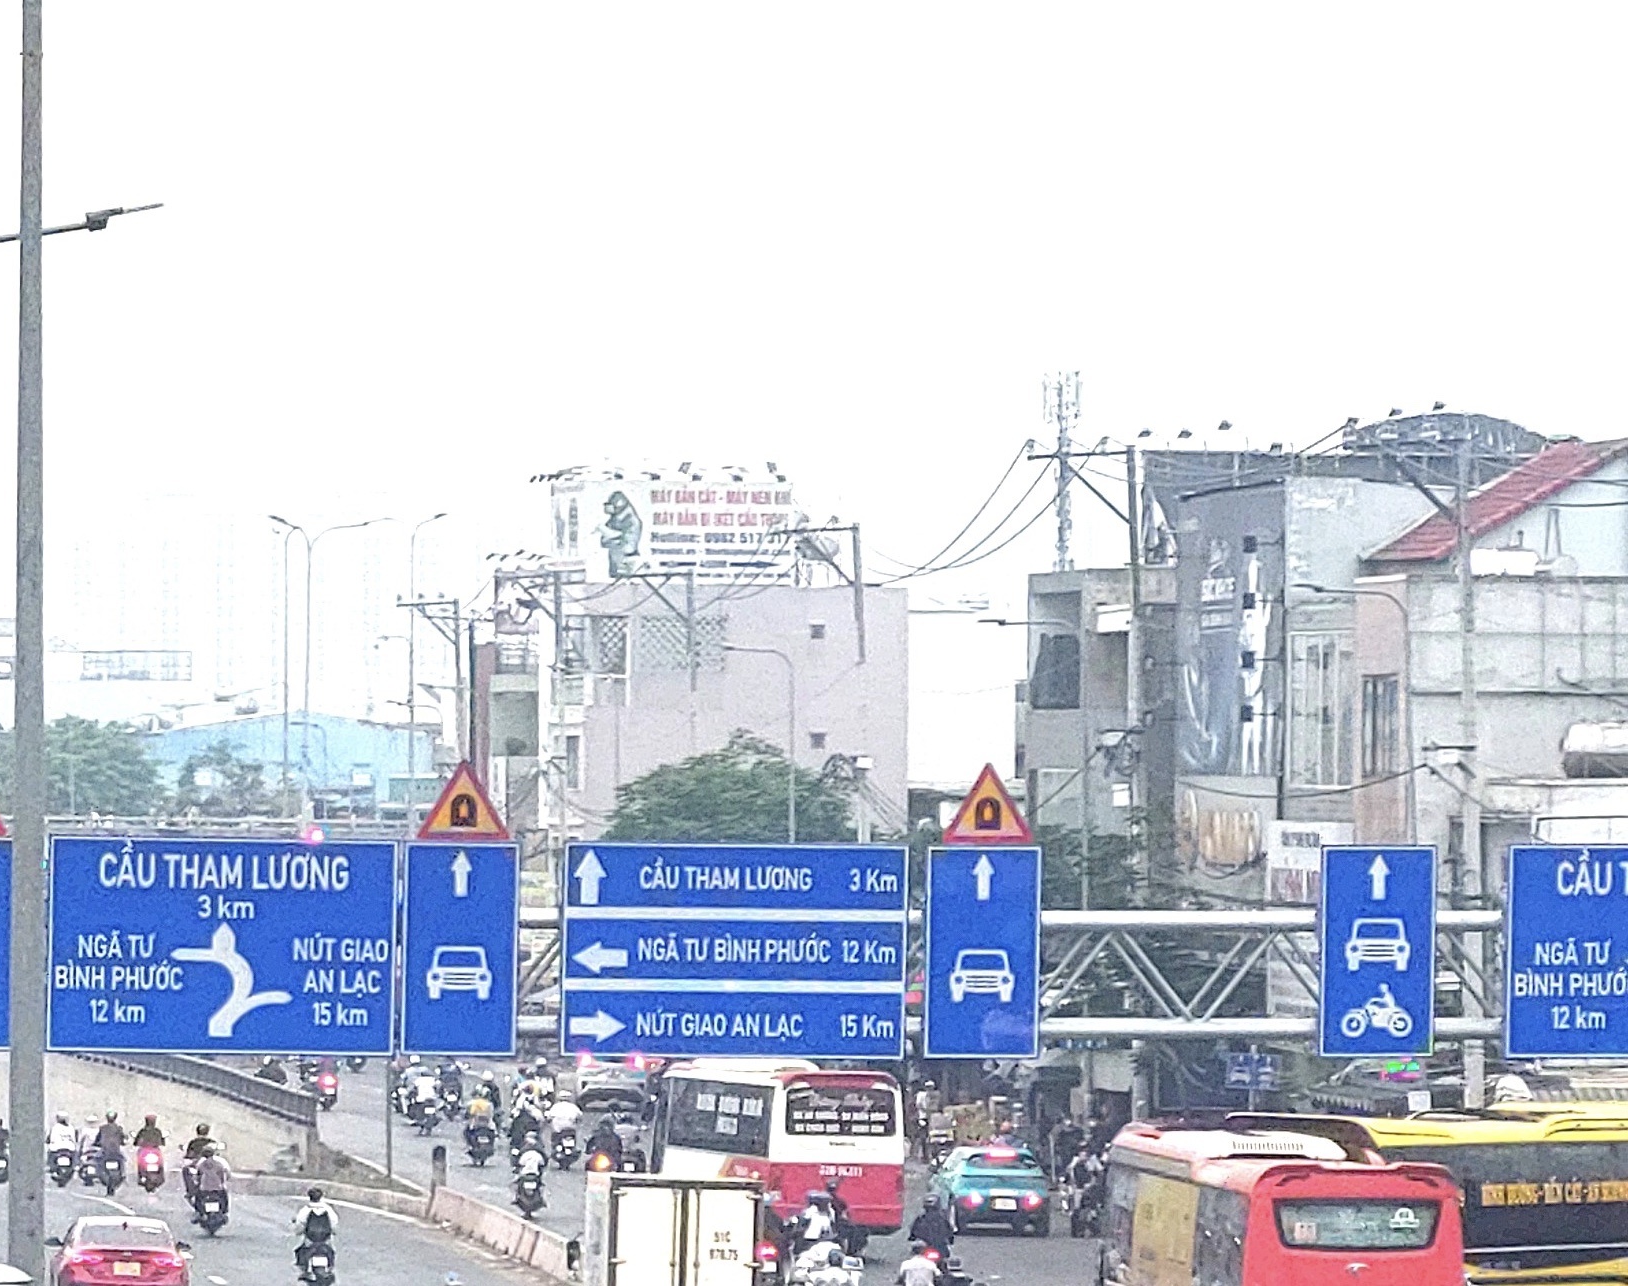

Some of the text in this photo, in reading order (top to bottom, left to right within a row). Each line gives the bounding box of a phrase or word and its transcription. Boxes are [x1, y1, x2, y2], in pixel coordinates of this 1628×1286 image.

[99, 843, 348, 890] CẦU THAM LƯƠNG
[640, 857, 811, 890] CẦU THAM LƯƠNG
[1557, 850, 1612, 895] CẦU
[850, 869, 897, 892] 3 Km
[198, 896, 254, 918] 3 km
[79, 930, 154, 957] NGÃ TƯ
[294, 933, 388, 962] NÚT GIAO
[639, 933, 830, 962] NGÃ TƯ BÌNH PHƯỚC
[843, 941, 895, 963] 12 Km
[1536, 938, 1612, 965] NGÃ TƯ
[55, 960, 183, 990] BÌNH PHƯỚC
[304, 970, 380, 997] AN LẠC
[1515, 967, 1628, 996] BÌNH PHƯỚ
[91, 999, 144, 1022] 12 km
[313, 1002, 367, 1025] 15 km
[1552, 1006, 1605, 1028] 12 km
[637, 1009, 802, 1040] NÚT GIAO AN LẠC
[841, 1015, 893, 1037] 15 Km
